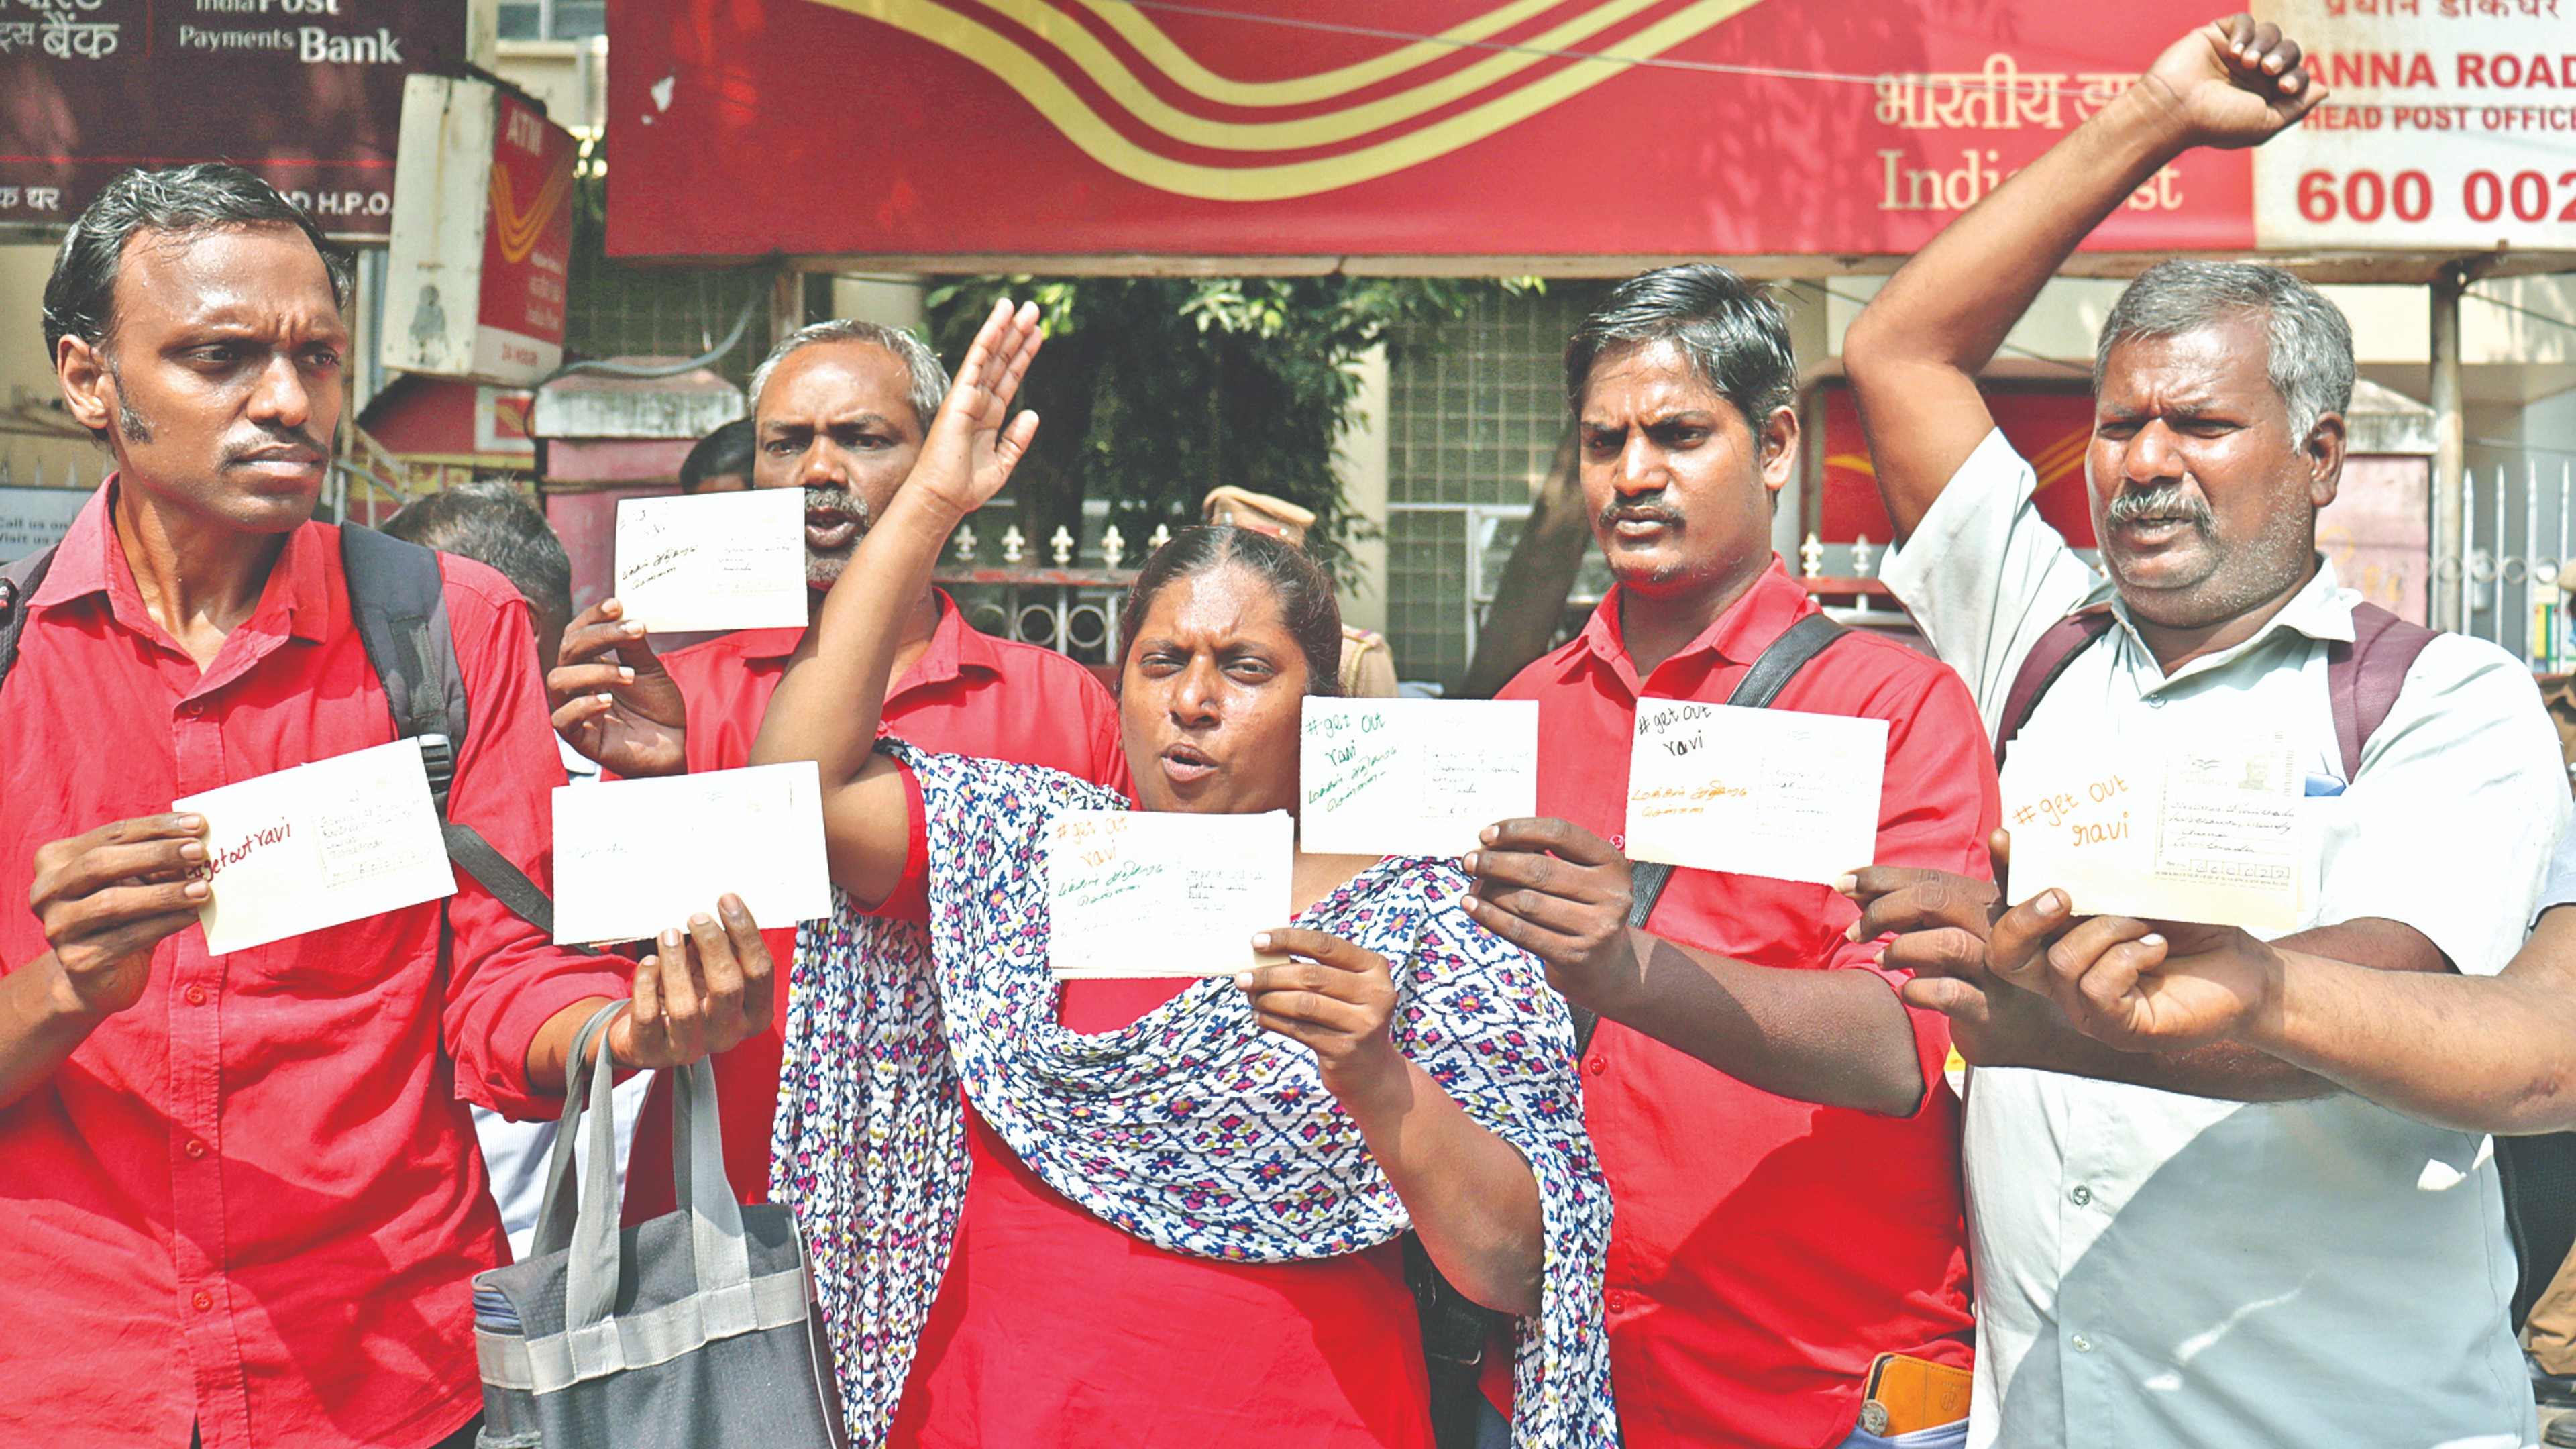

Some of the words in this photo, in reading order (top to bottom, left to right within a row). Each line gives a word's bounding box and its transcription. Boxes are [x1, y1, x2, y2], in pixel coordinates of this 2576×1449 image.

[40, 11, 120, 59] बैंक
[179, 25, 296, 52] Payments
[298, 26, 403, 64] Bank
[1875, 53, 2067, 129] भारतीय
[2303, 52, 2439, 89] ANNA
[2303, 105, 2382, 130] HEAD
[2394, 106, 2470, 130] POST
[1878, 148, 2021, 210] Indi
[2297, 169, 2432, 223] 600
